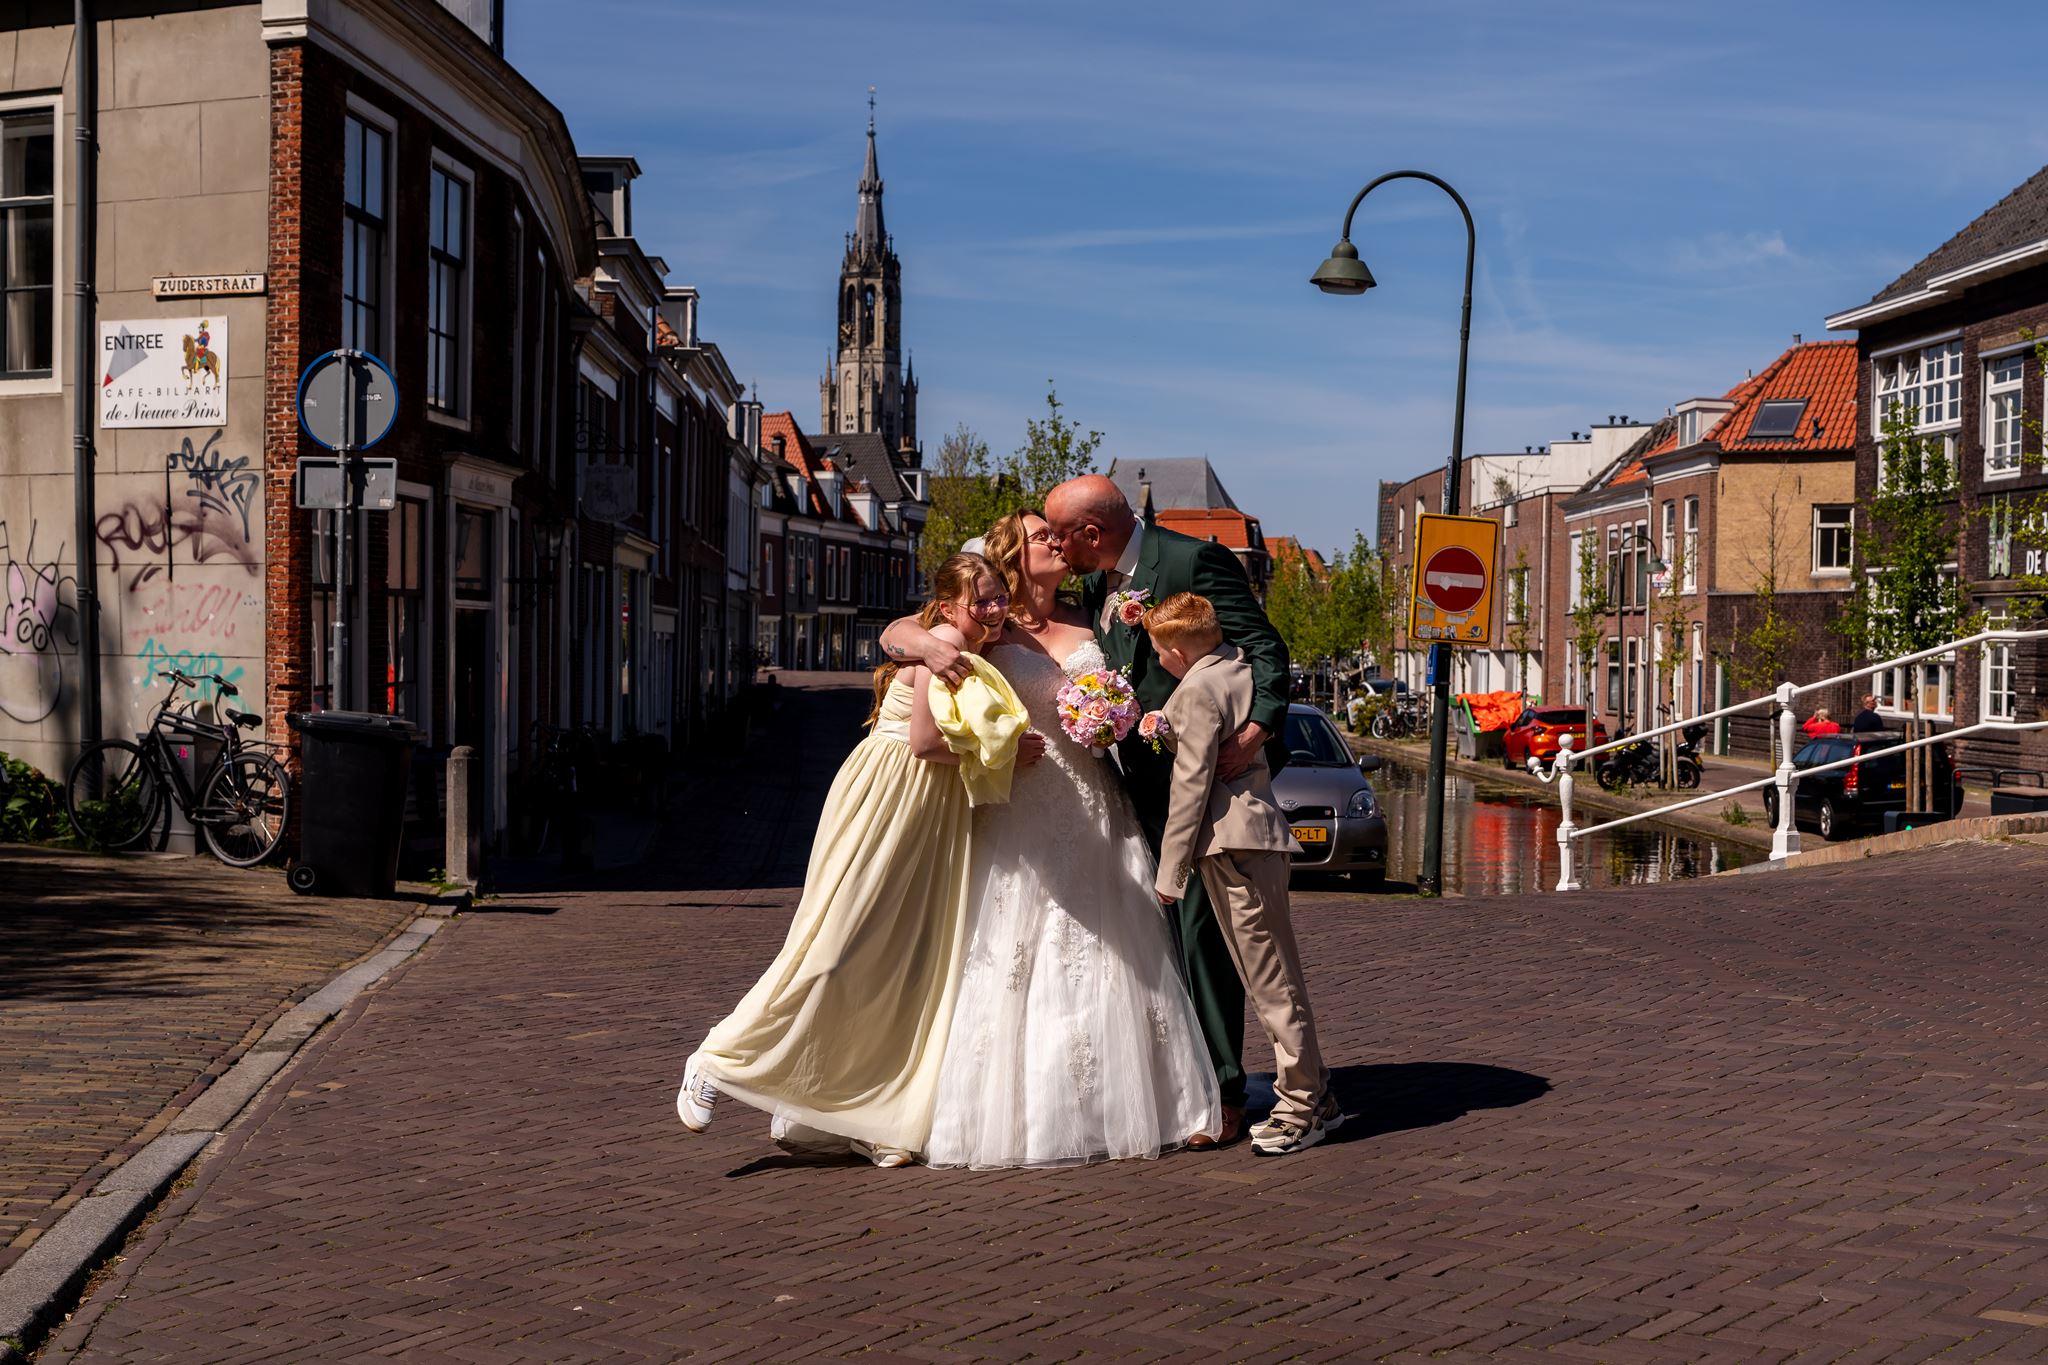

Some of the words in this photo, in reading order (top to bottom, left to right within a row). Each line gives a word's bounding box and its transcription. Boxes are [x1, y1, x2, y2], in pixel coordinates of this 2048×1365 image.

[159, 277, 257, 292] ZUIDERSTRAAT
[105, 333, 164, 350] ENTREE
[105, 404, 122, 420] de
[124, 401, 180, 420] Nieuwe
[181, 399, 221, 419] Prins
[2025, 549, 2042, 576] DE
